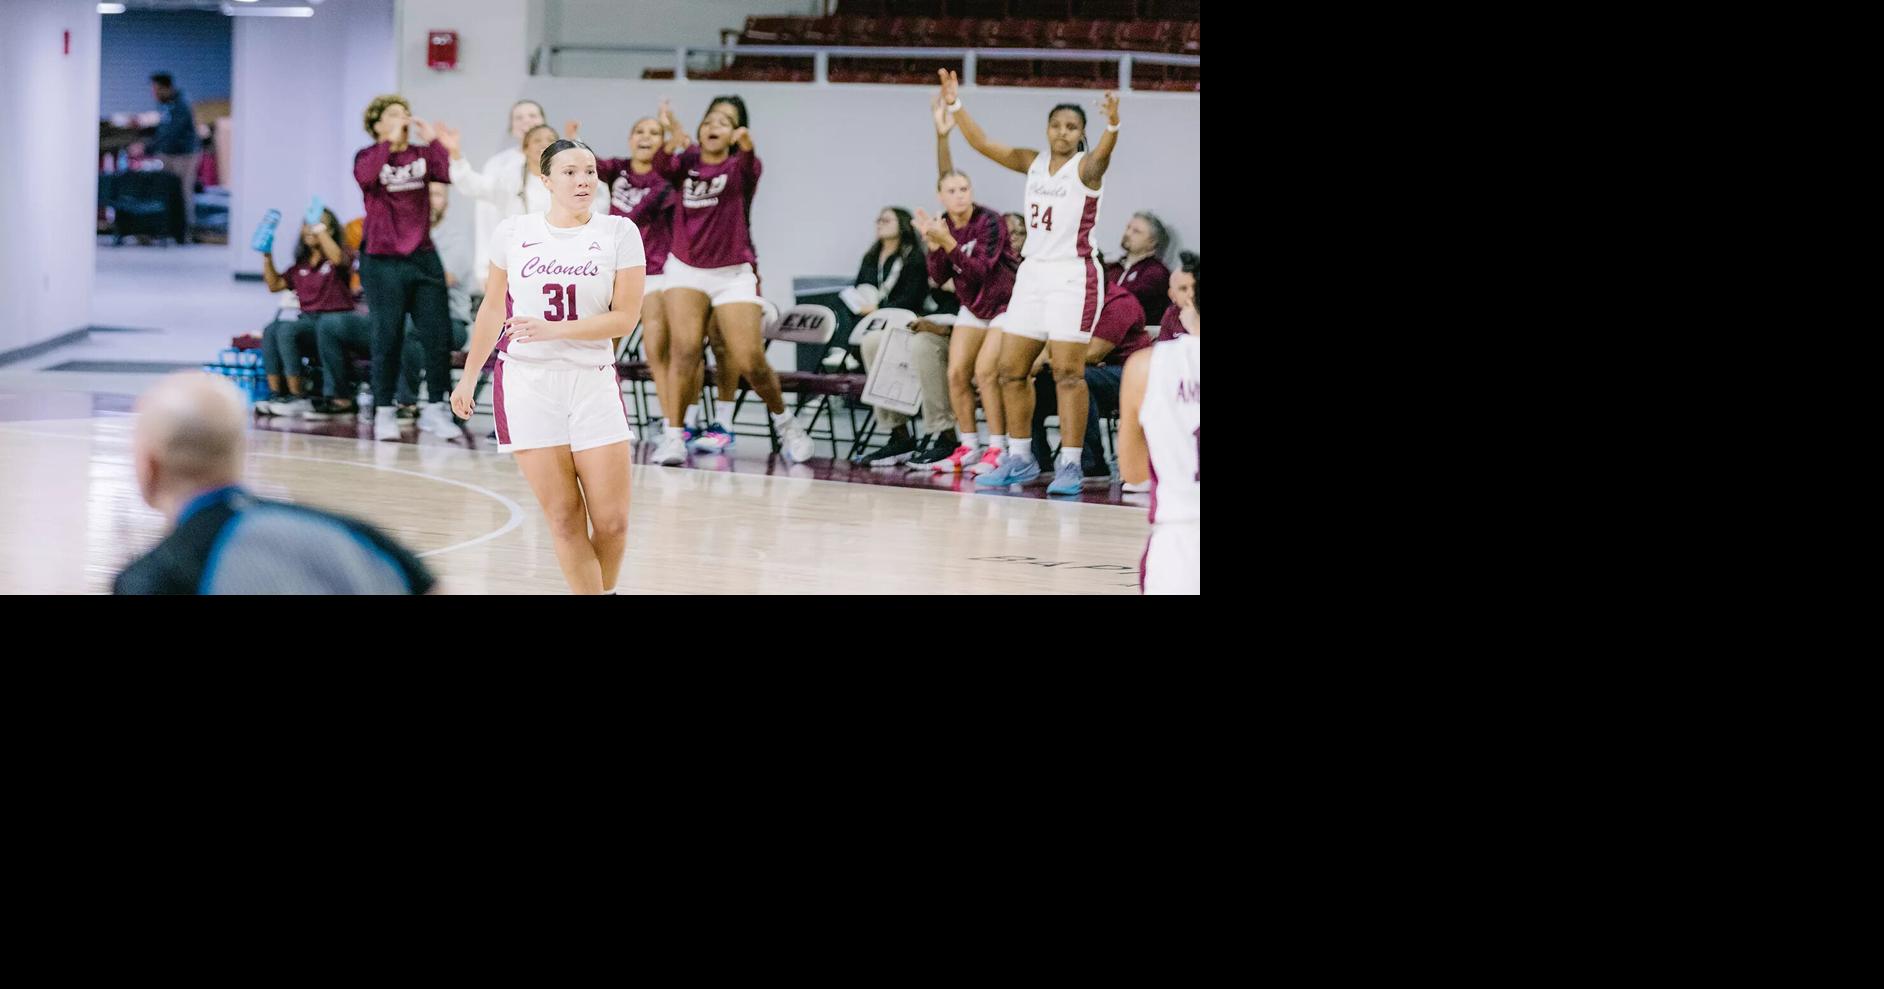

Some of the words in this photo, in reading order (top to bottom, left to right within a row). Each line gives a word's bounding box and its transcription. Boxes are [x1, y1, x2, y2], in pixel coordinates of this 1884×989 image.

[1031, 203, 1053, 232] 24
[520, 256, 600, 278] Colonels
[542, 283, 578, 322] 31
[781, 313, 825, 329] EKU
